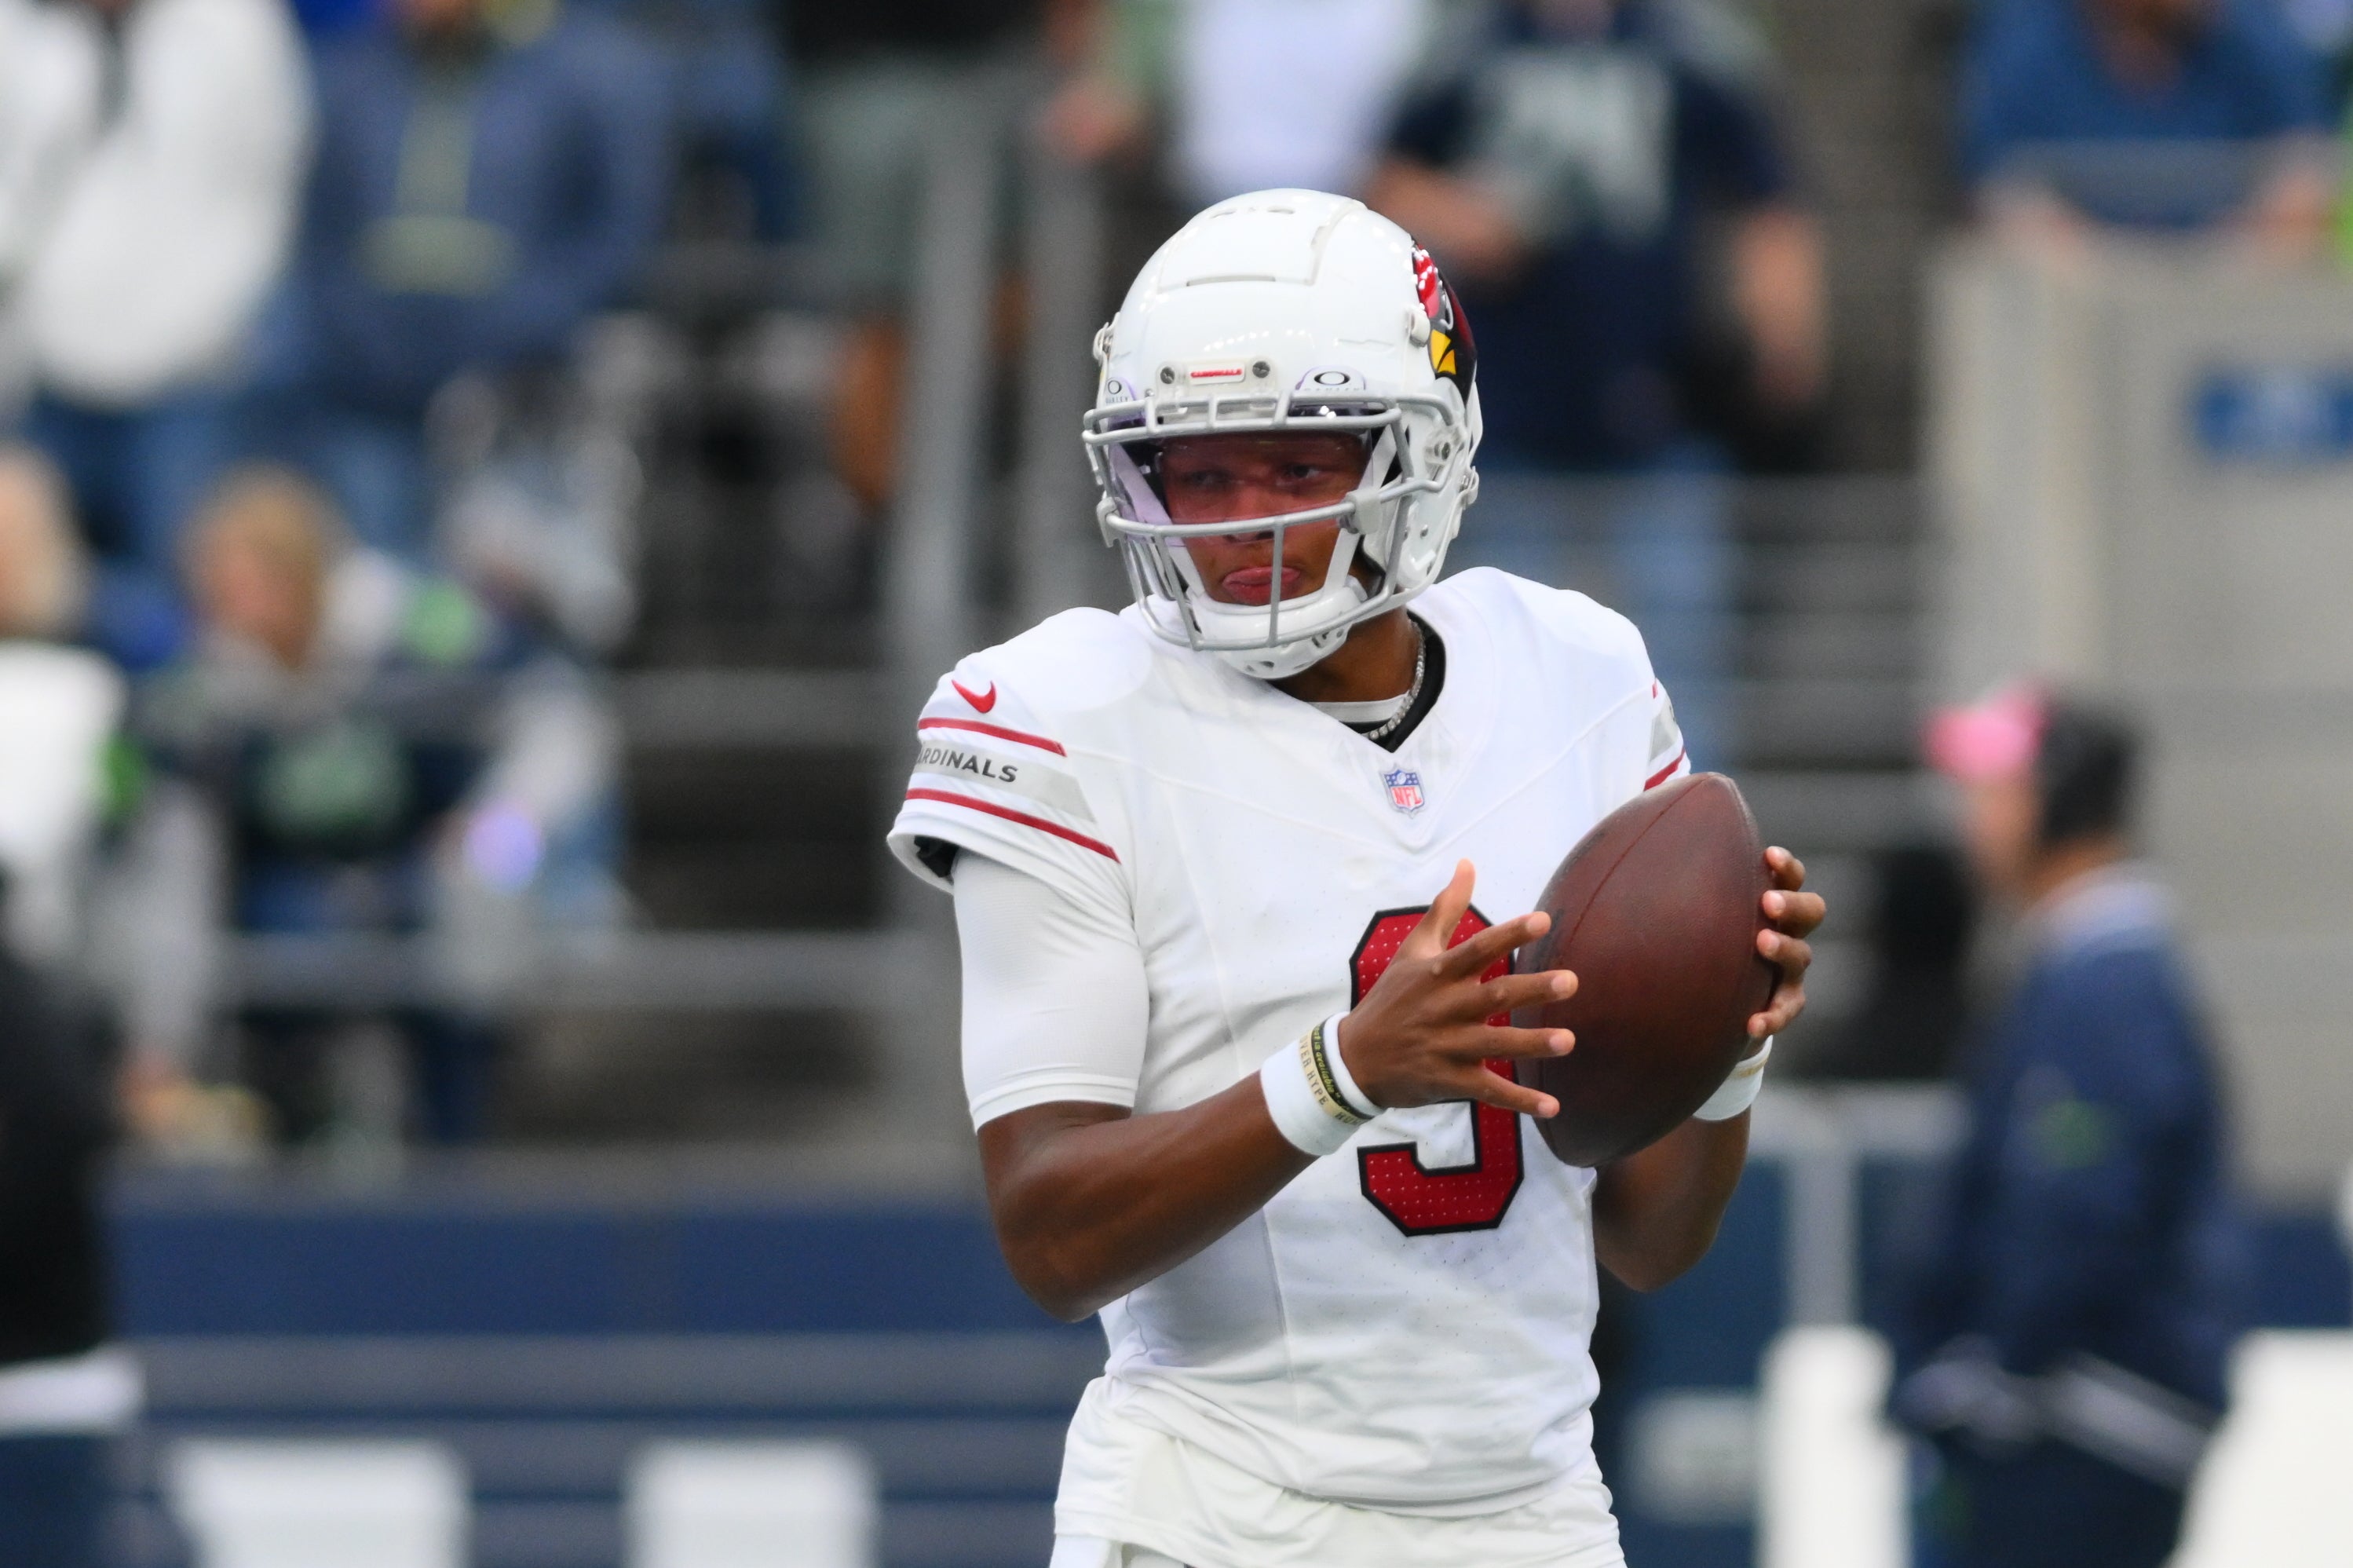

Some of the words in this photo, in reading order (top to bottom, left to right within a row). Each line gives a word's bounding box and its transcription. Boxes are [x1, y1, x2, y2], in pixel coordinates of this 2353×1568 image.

[917, 747, 1019, 783] ARDINALS
[1391, 785, 1423, 807] NFL
[1306, 1070, 1328, 1106] HYPE
